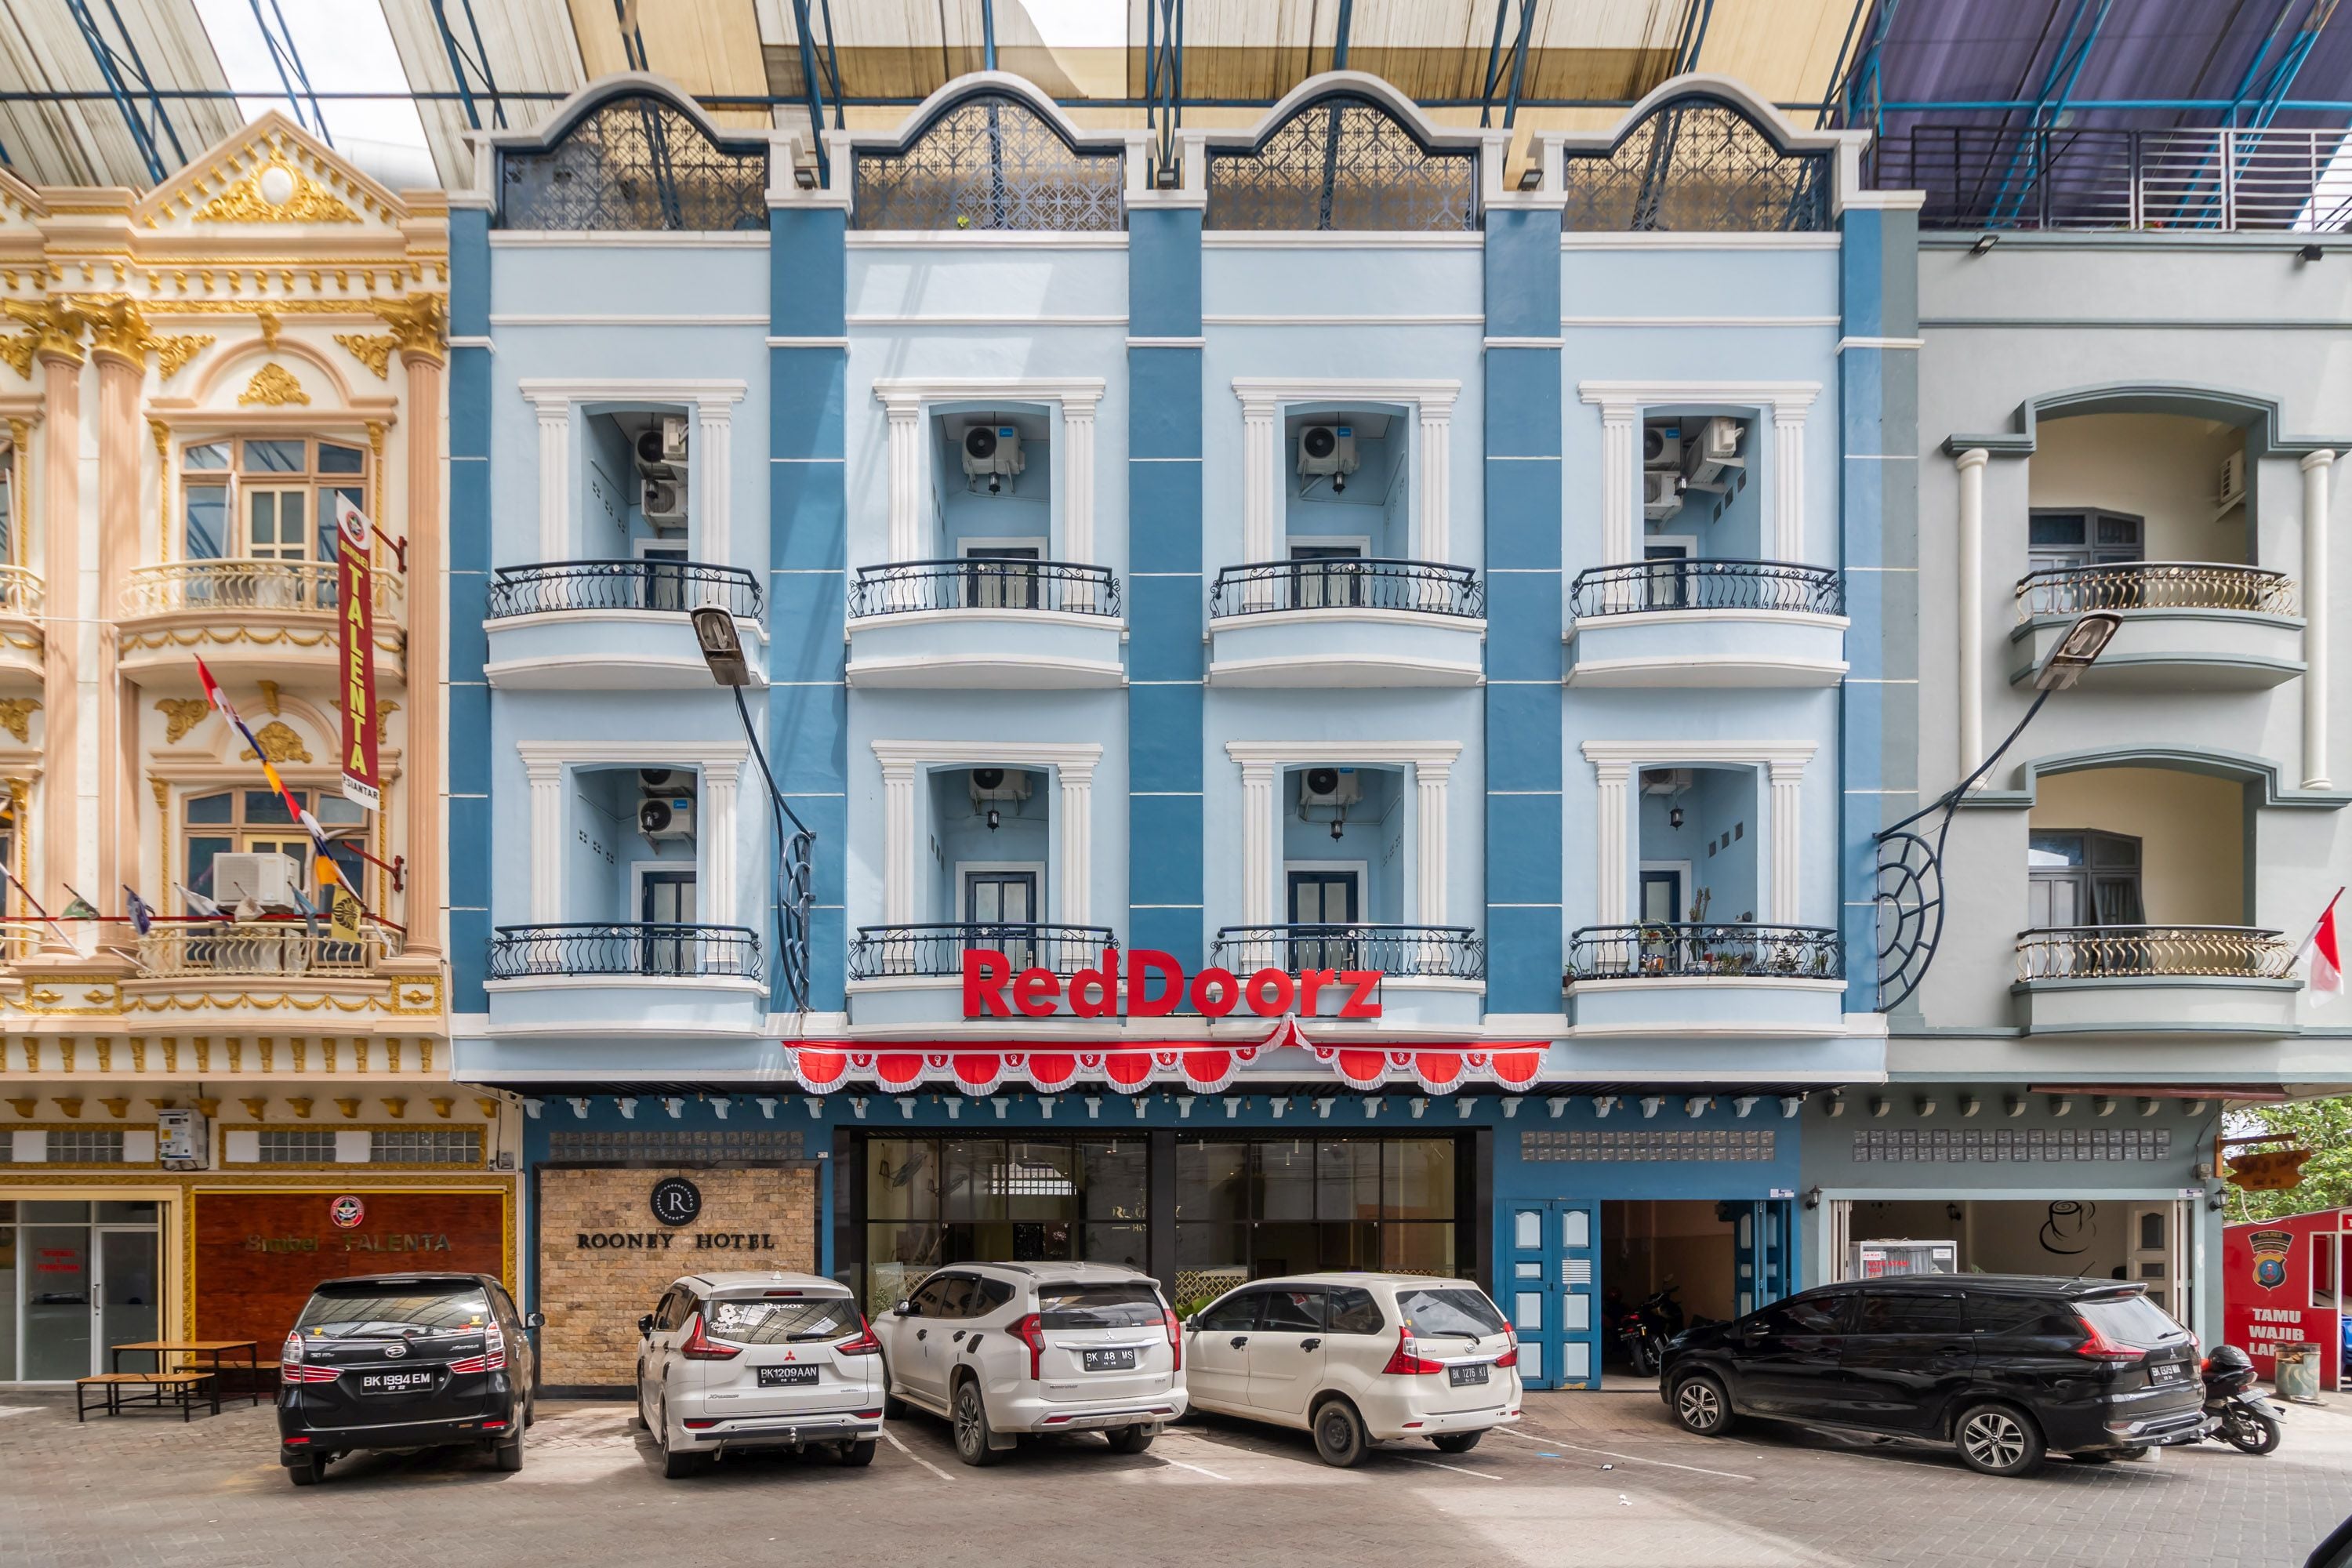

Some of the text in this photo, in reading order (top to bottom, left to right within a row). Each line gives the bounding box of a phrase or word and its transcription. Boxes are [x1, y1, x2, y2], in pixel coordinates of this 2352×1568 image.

[348, 562, 368, 776] TALENTA
[963, 949, 1384, 1018] RedDoorz
[669, 1192, 695, 1212] R
[341, 1234, 452, 1252] TALENTA
[576, 1233, 775, 1250] ROONEY HOTEL
[2252, 1308, 2301, 1323] TAMU
[2249, 1325, 2305, 1341] WAJIB
[1086, 1350, 1134, 1363] BK 48 MS
[364, 1373, 430, 1387] BK 1994 EM
[1462, 1367, 1475, 1378] 1276
